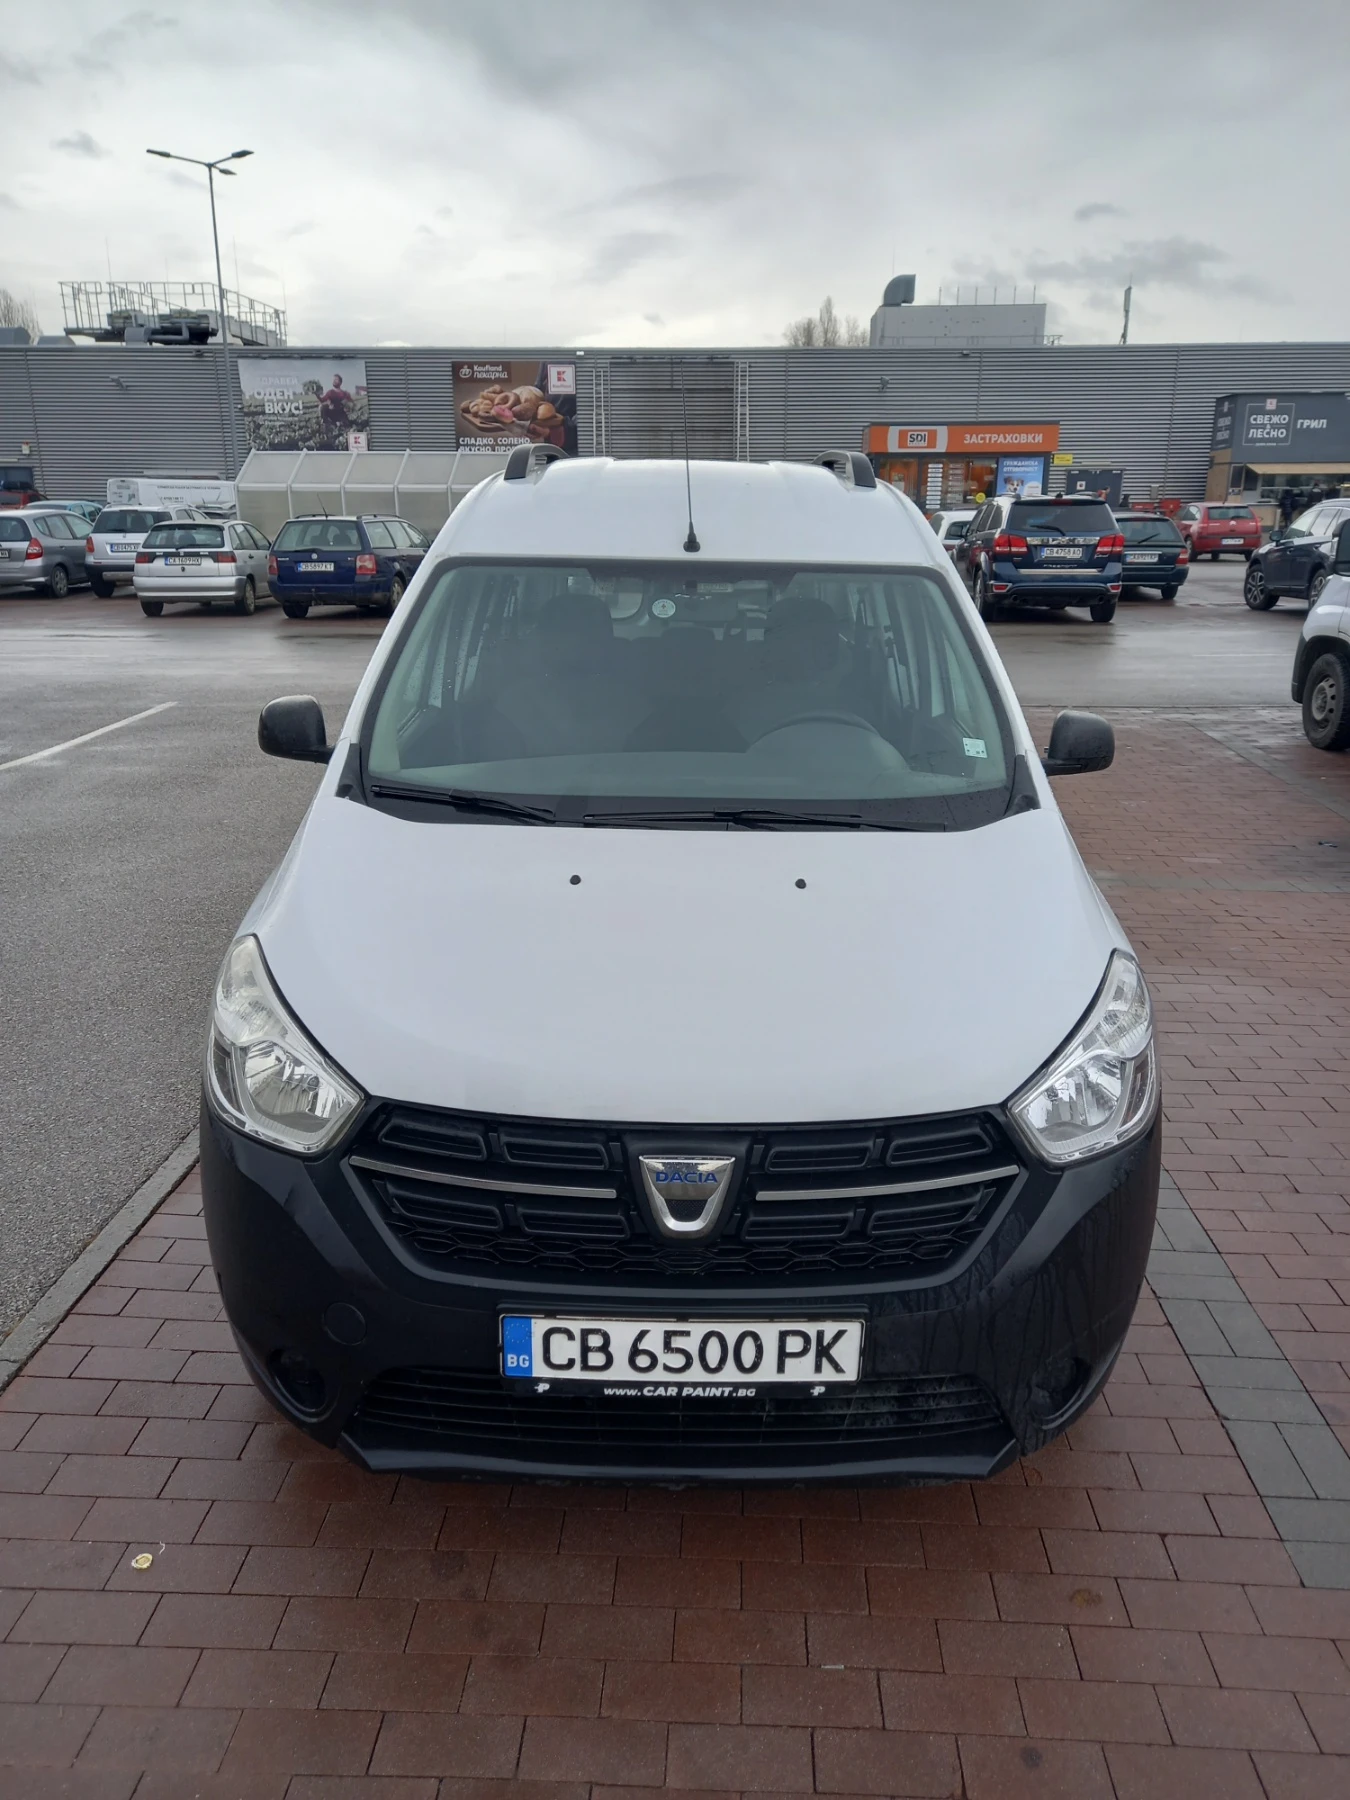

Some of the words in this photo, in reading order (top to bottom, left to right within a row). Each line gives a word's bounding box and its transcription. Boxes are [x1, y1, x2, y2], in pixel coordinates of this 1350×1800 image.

[264, 400, 303, 414] ВКУС!
[1250, 414, 1289, 424] СВЕЖО
[1297, 419, 1328, 429] ГРИЛ
[909, 433, 927, 443] SDI
[963, 433, 1043, 444] ЗАСТРАХОВКИ
[1248, 429, 1287, 438] ЛЕСНО
[655, 1171, 718, 1184] DACIA
[542, 1326, 614, 1372] CB
[627, 1329, 764, 1375] 6500
[776, 1329, 849, 1375] PK
[507, 1354, 530, 1368] BG
